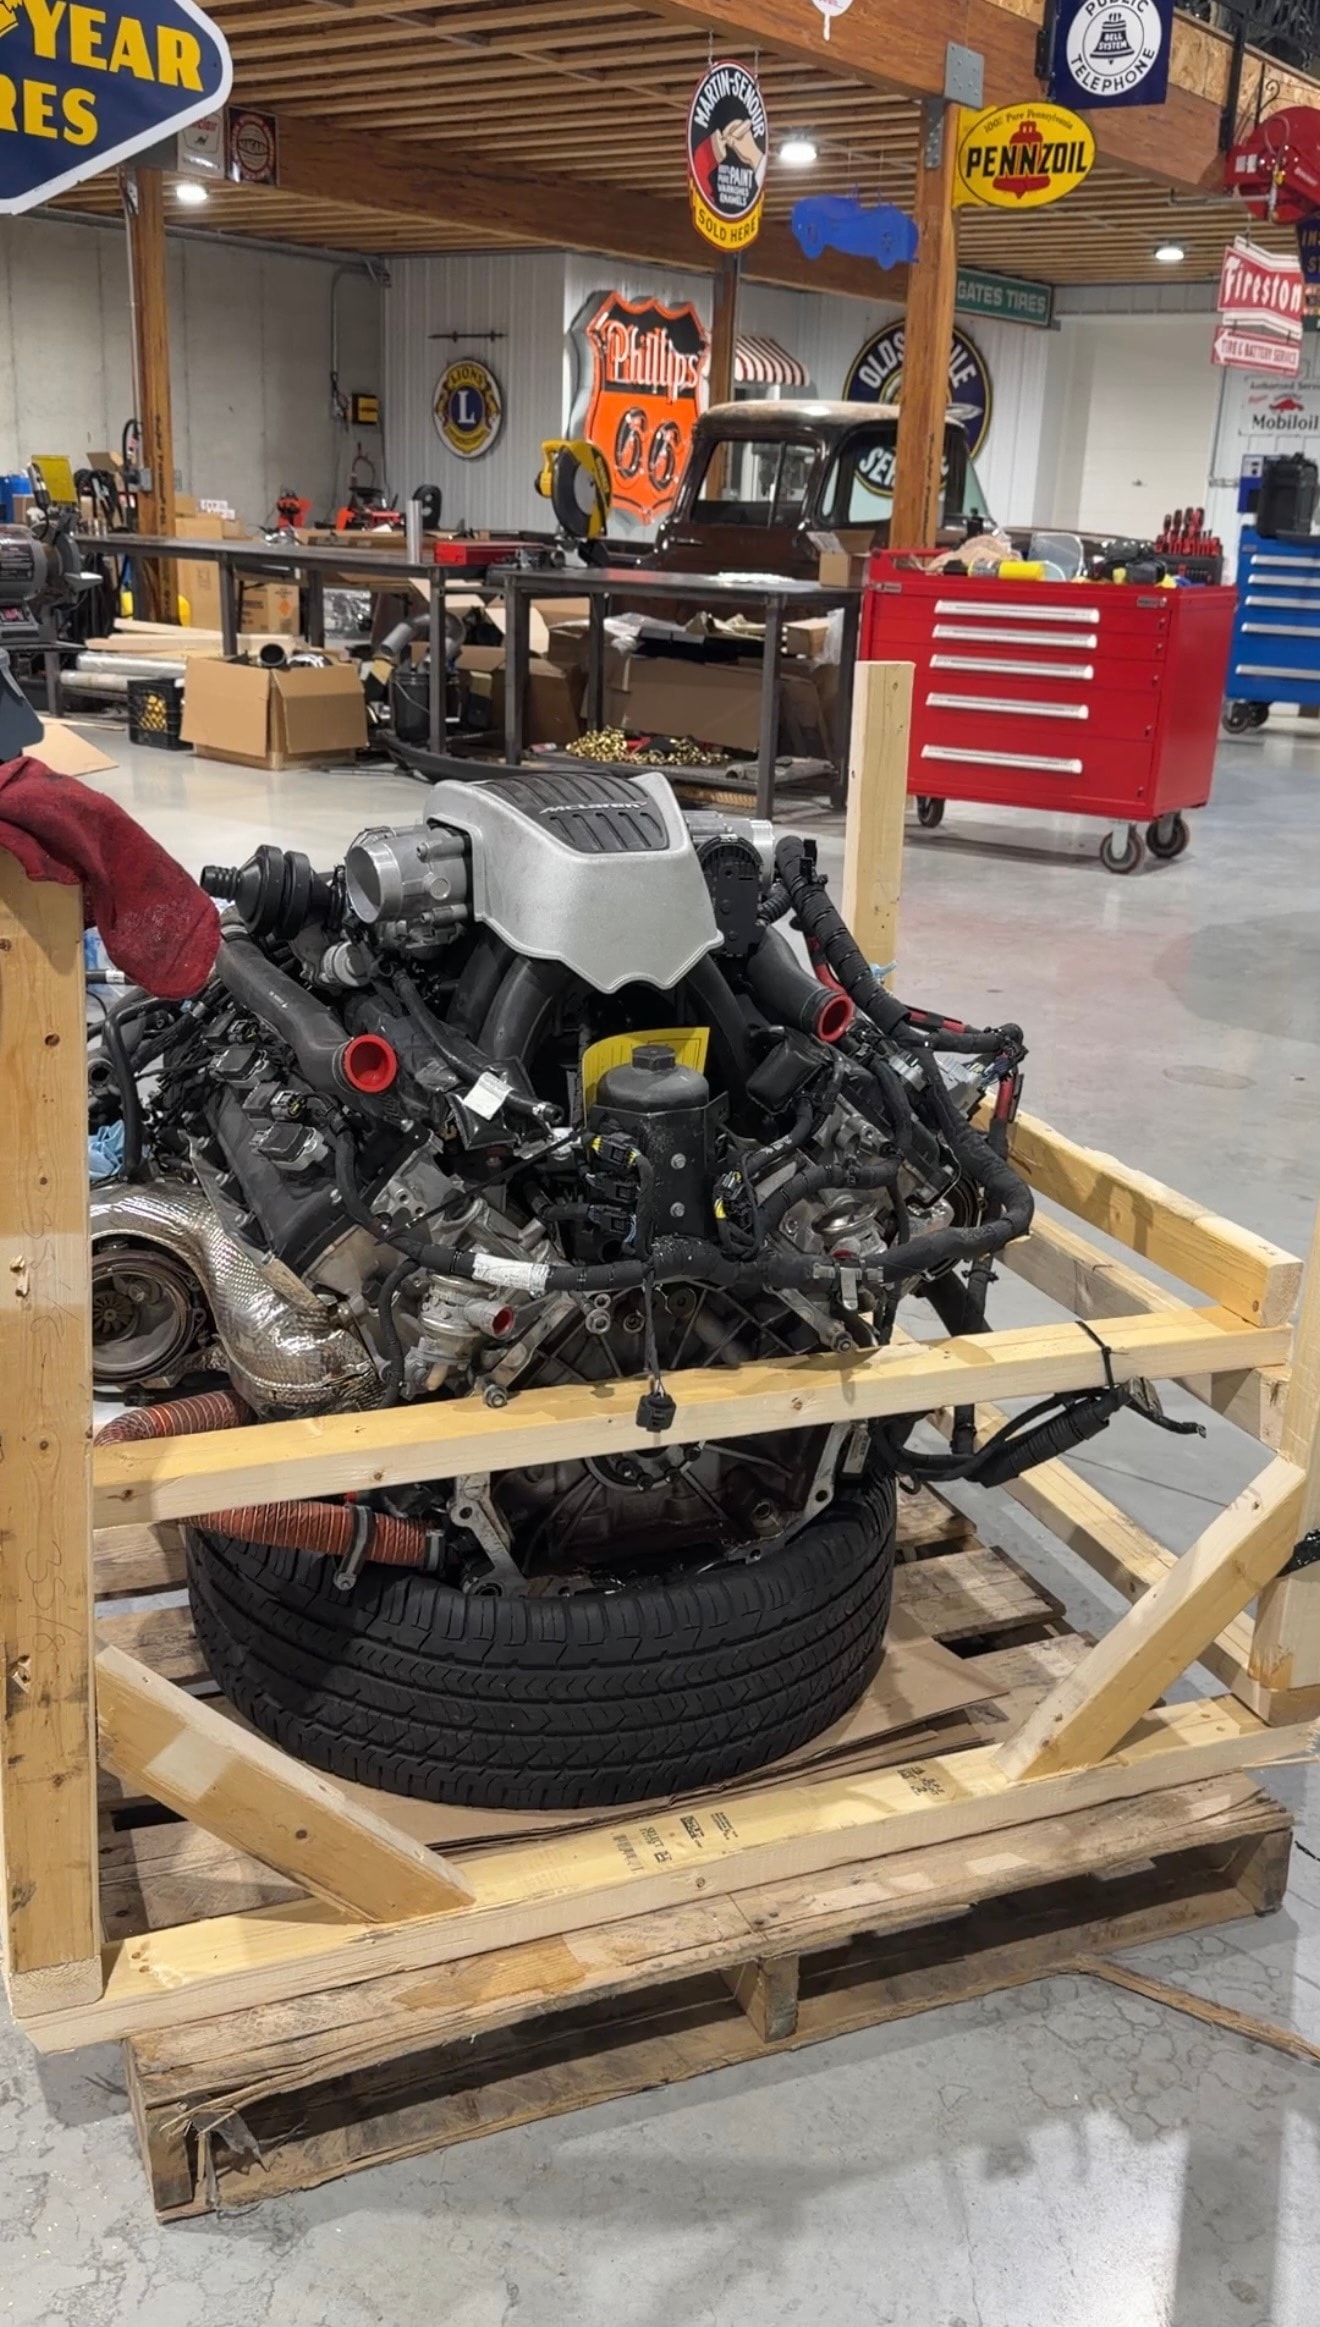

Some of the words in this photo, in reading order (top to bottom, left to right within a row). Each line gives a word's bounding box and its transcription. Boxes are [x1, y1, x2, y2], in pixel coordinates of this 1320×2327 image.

[1085, 0, 1149, 16] PUIC
[22, 0, 204, 92] YEAR
[1098, 40, 1128, 50] SYSTEM
[1104, 32, 1123, 41] BELL
[1071, 48, 1155, 92] TELEPHONE
[694, 70, 765, 138] MARTIN-SENOUR
[966, 141, 1087, 178] PENNZOIL
[730, 165, 753, 189] PAINT
[698, 209, 727, 241] SOLD
[730, 216, 757, 242] HERE
[957, 280, 1003, 307] GATES
[1006, 289, 1047, 314] TIRES
[450, 366, 486, 384] LIONS
[606, 320, 699, 404] Phillips
[858, 331, 977, 389] OLDSILE
[456, 390, 476, 424] L
[1251, 414, 1319, 430] Mobiloil
[615, 407, 681, 491] 66
